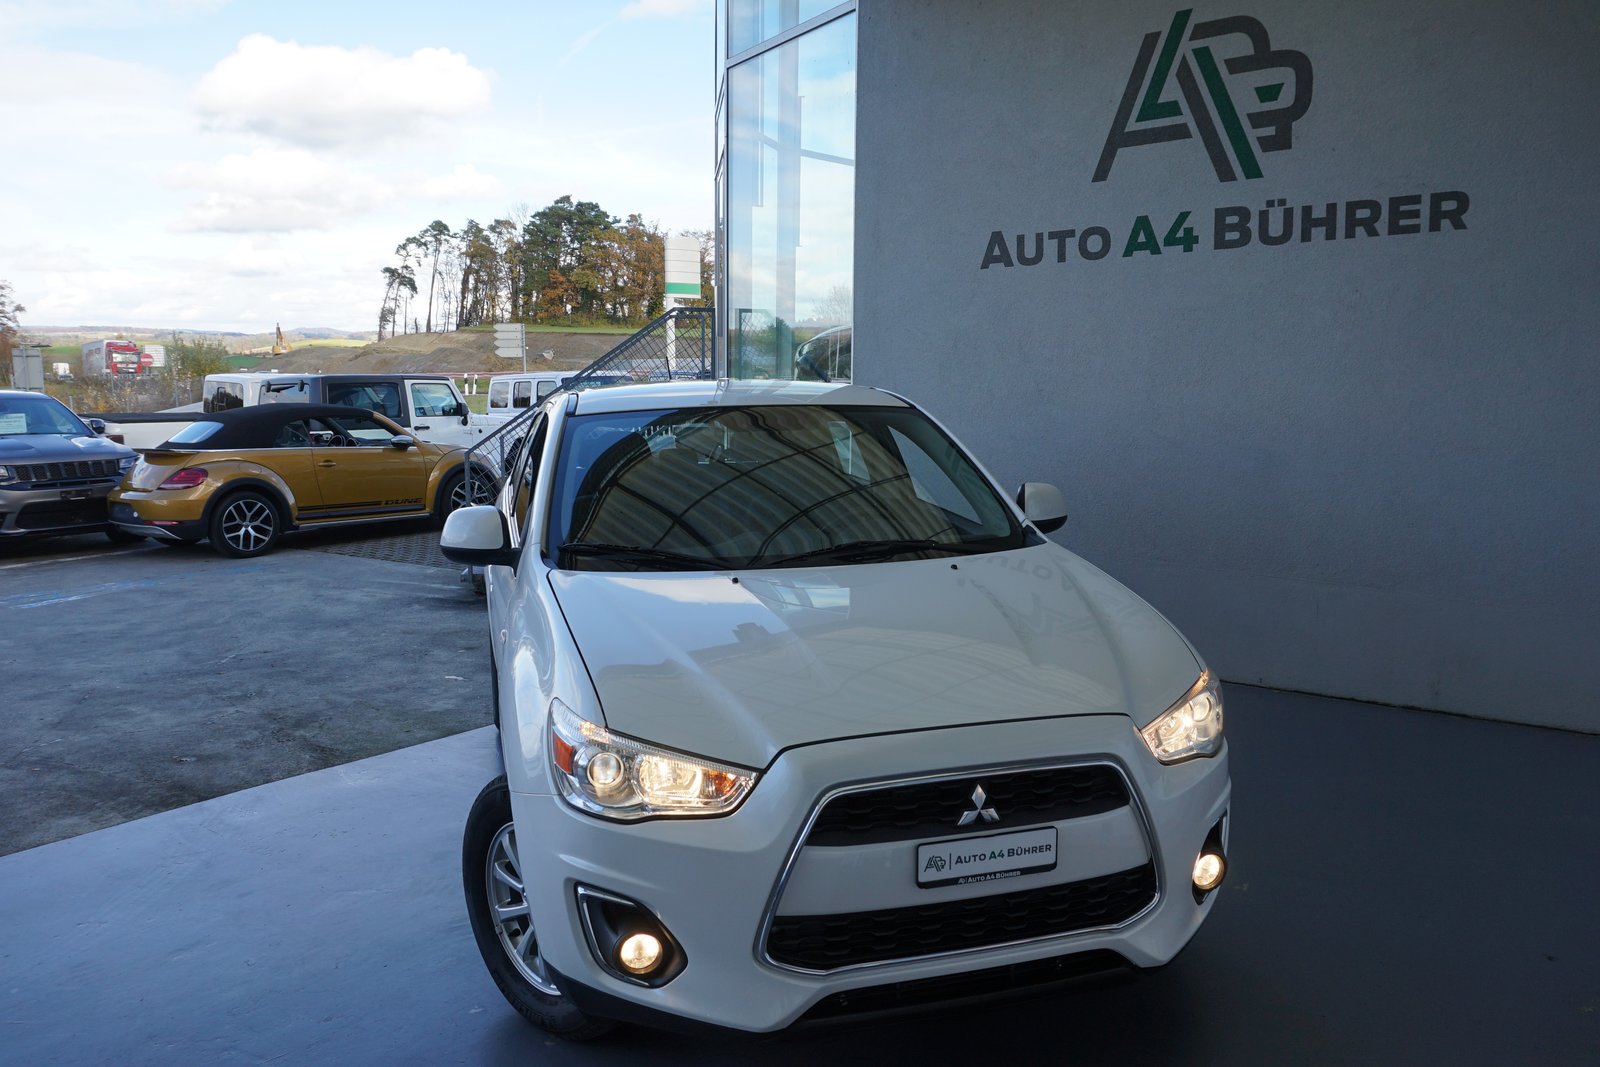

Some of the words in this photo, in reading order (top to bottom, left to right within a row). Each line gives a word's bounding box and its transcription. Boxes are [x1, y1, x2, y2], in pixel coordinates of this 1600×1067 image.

[980, 225, 1112, 270] AUTO
[1122, 210, 1199, 258] A4
[1212, 190, 1471, 251] BÜHRER
[384, 497, 423, 505] DUNE
[954, 853, 987, 865] AUTO
[988, 850, 1006, 861] A4
[1007, 844, 1052, 858] BÜHRER
[967, 875, 985, 883] AUTO
[985, 873, 996, 881] A4
